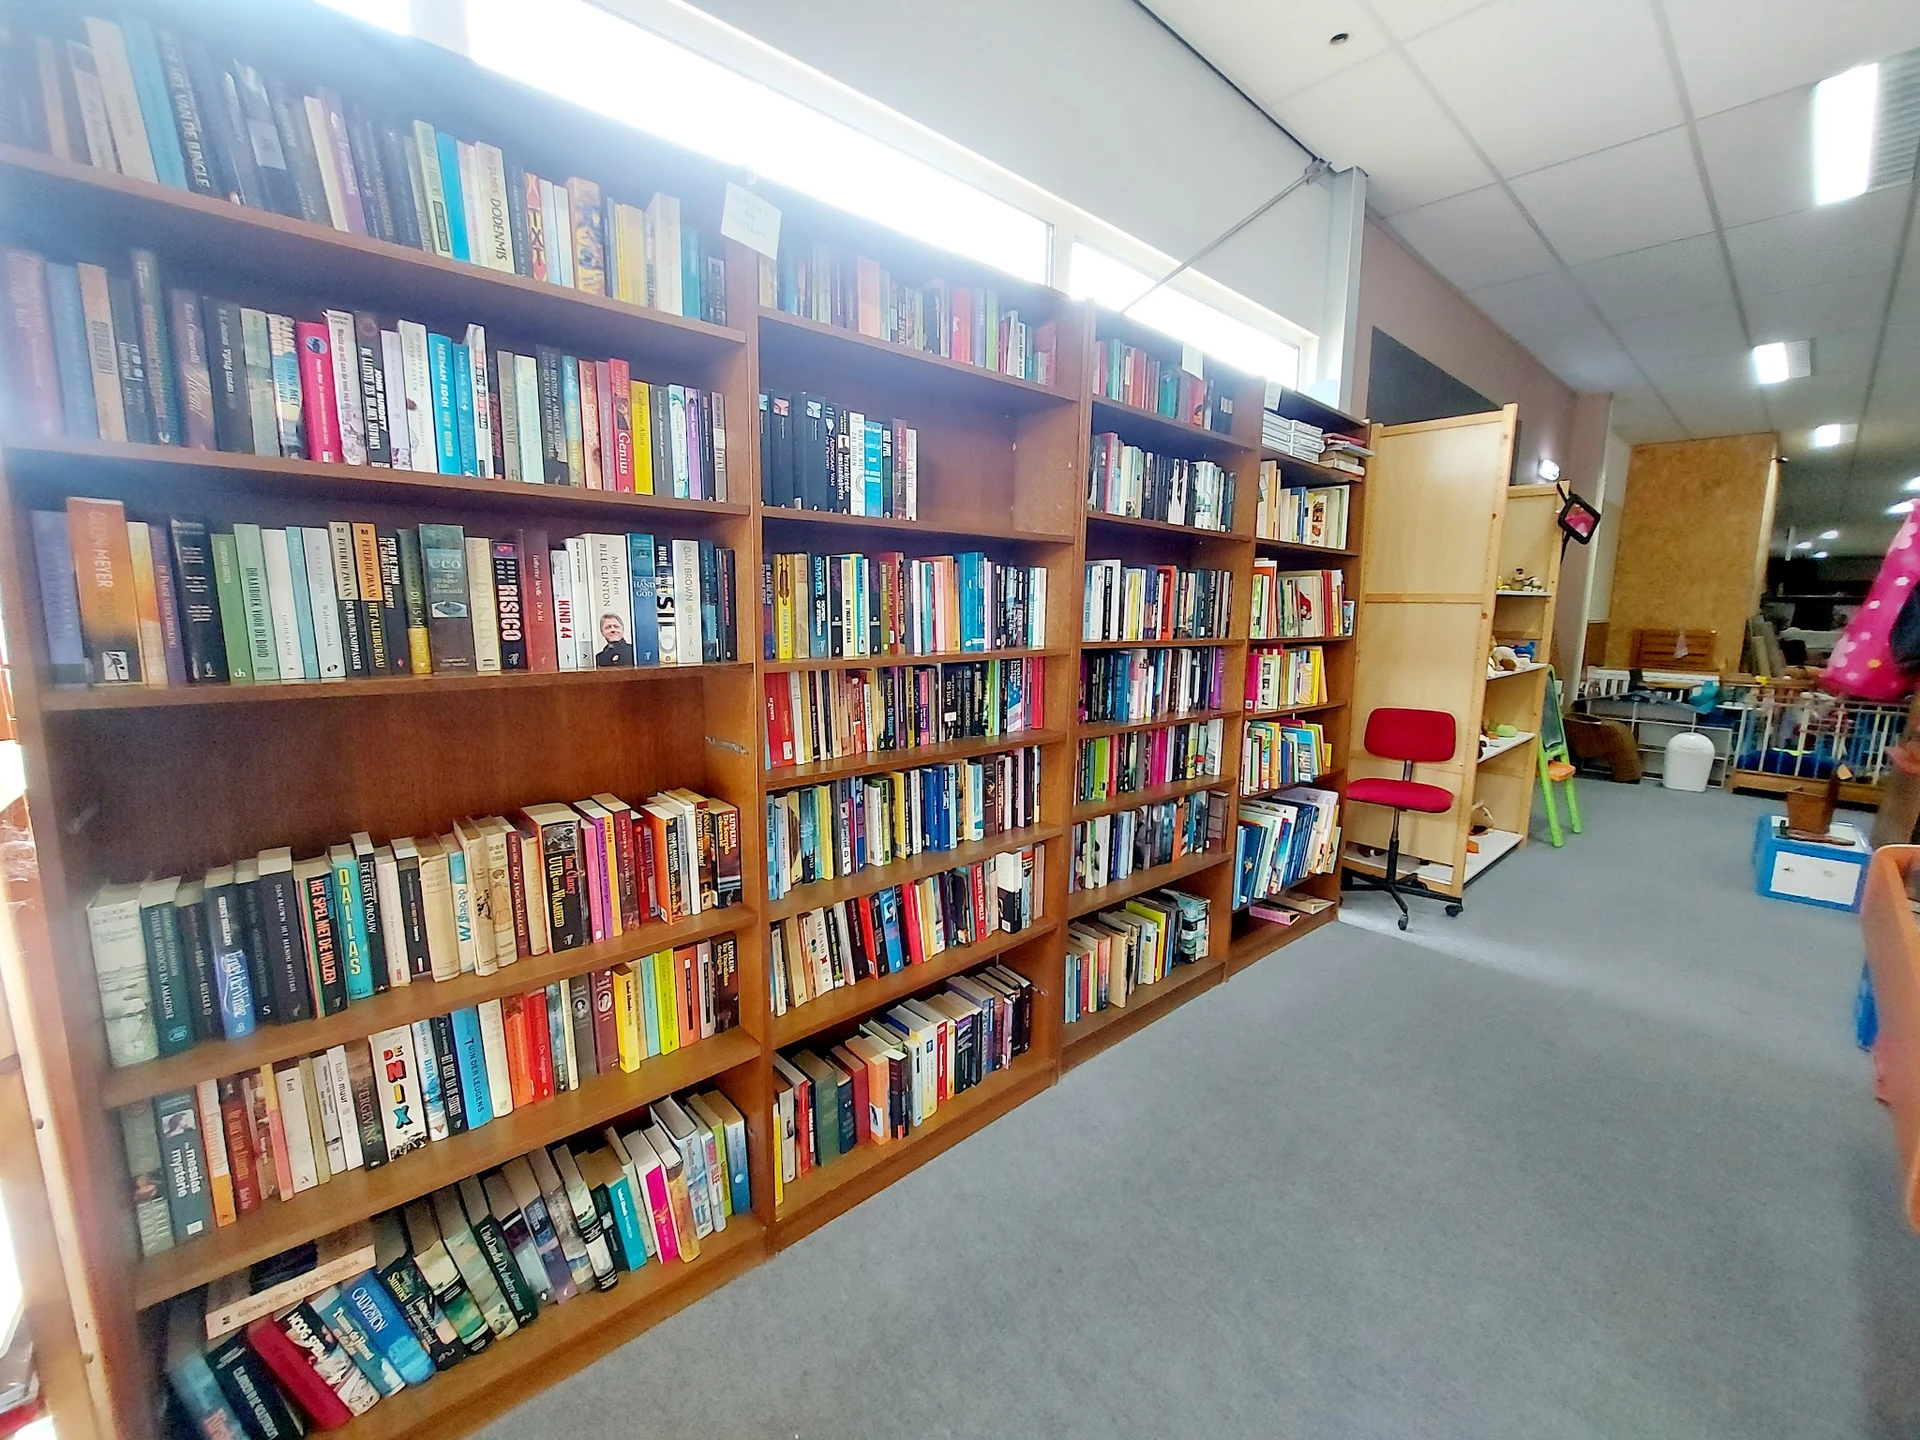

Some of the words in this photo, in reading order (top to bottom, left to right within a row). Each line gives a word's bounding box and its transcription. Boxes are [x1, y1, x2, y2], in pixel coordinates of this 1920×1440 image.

[174, 92, 192, 120] VAN
[490, 197, 508, 261] DODENMIS
[437, 342, 448, 381] HERMAN
[374, 369, 385, 392] JOHN
[440, 382, 450, 409] KOCH
[618, 431, 633, 475] Genius
[599, 542, 610, 562] BILL
[657, 545, 668, 566] HUGH
[683, 546, 693, 566] DAN
[95, 547, 115, 589] MEYER
[496, 560, 506, 580] COOK
[610, 555, 622, 577] Mijn
[245, 566, 262, 609] DRAAIBOEK
[600, 564, 612, 607] CLINTON
[612, 576, 623, 596] leven
[684, 567, 694, 602] BROWN
[252, 609, 264, 628] VOOR
[367, 602, 379, 618] HET
[498, 584, 522, 642] RISICO
[557, 599, 573, 625] KIND
[255, 628, 265, 640] DE
[559, 626, 573, 640] 44
[255, 639, 269, 659] DOOD
[728, 813, 738, 848] LUDLUM
[360, 861, 370, 873] DE
[547, 855, 564, 880] UUR
[565, 853, 577, 870] Tom
[274, 883, 284, 899] DAN
[309, 879, 324, 897] HET
[361, 874, 374, 903] EERSTE
[566, 869, 581, 897] Clancy
[276, 898, 286, 922] BROWN
[313, 897, 327, 920] SPEL
[364, 902, 378, 935] VROUW
[551, 889, 567, 930] WAARHEID
[150, 909, 162, 938] TUSSEN
[317, 919, 331, 940] MET
[337, 868, 362, 977] DALLAS
[154, 938, 167, 972] ORINOCO
[320, 939, 331, 953] DE
[727, 940, 736, 974] LUDLUM
[159, 973, 169, 985] EN
[321, 952, 338, 986] HULZEN
[160, 984, 175, 1020] AMAZONE
[463, 1037, 478, 1060] TUIN
[469, 1059, 479, 1077] DER
[338, 1082, 348, 1105] muur
[472, 1076, 486, 1114] LEUGENS
[357, 1082, 377, 1147] VERGEVING
[184, 1147, 204, 1195] messias
[386, 1271, 411, 1302] Simmel
[286, 1311, 310, 1341] HOOG
